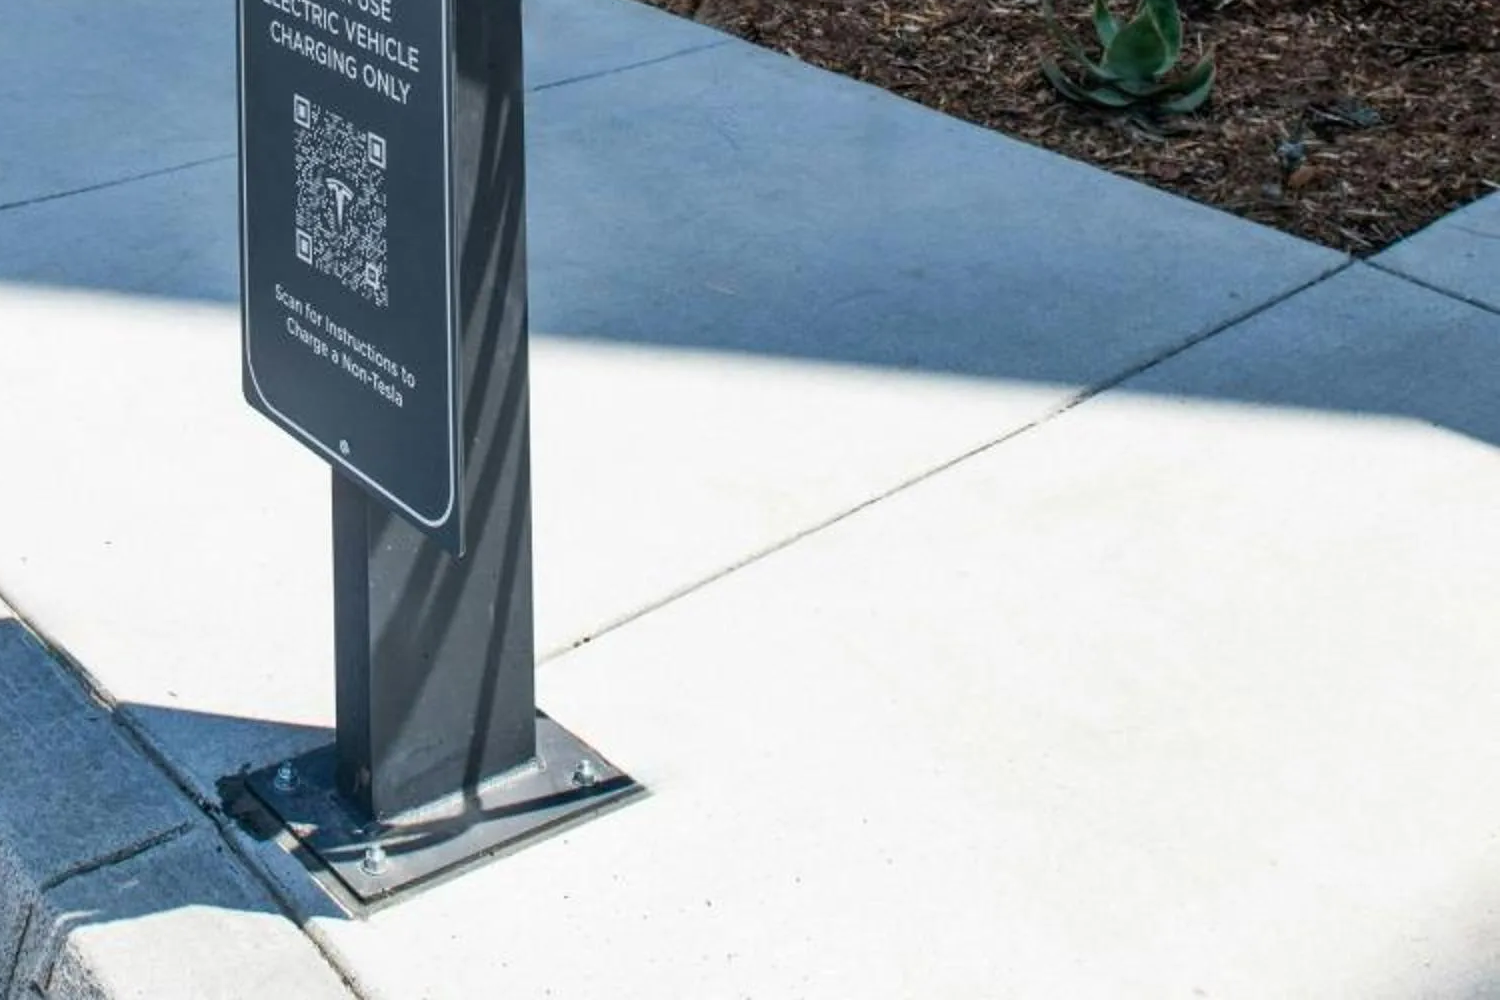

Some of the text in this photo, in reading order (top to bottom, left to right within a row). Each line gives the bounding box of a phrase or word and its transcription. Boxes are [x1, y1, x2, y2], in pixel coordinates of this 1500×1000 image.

[270, 20, 411, 105] CHARGING ONLY
[345, 17, 420, 73] VEHICLE
[275, 283, 415, 388] Scan for Instructions to
[286, 317, 403, 408] Charge a Non-Tesla
